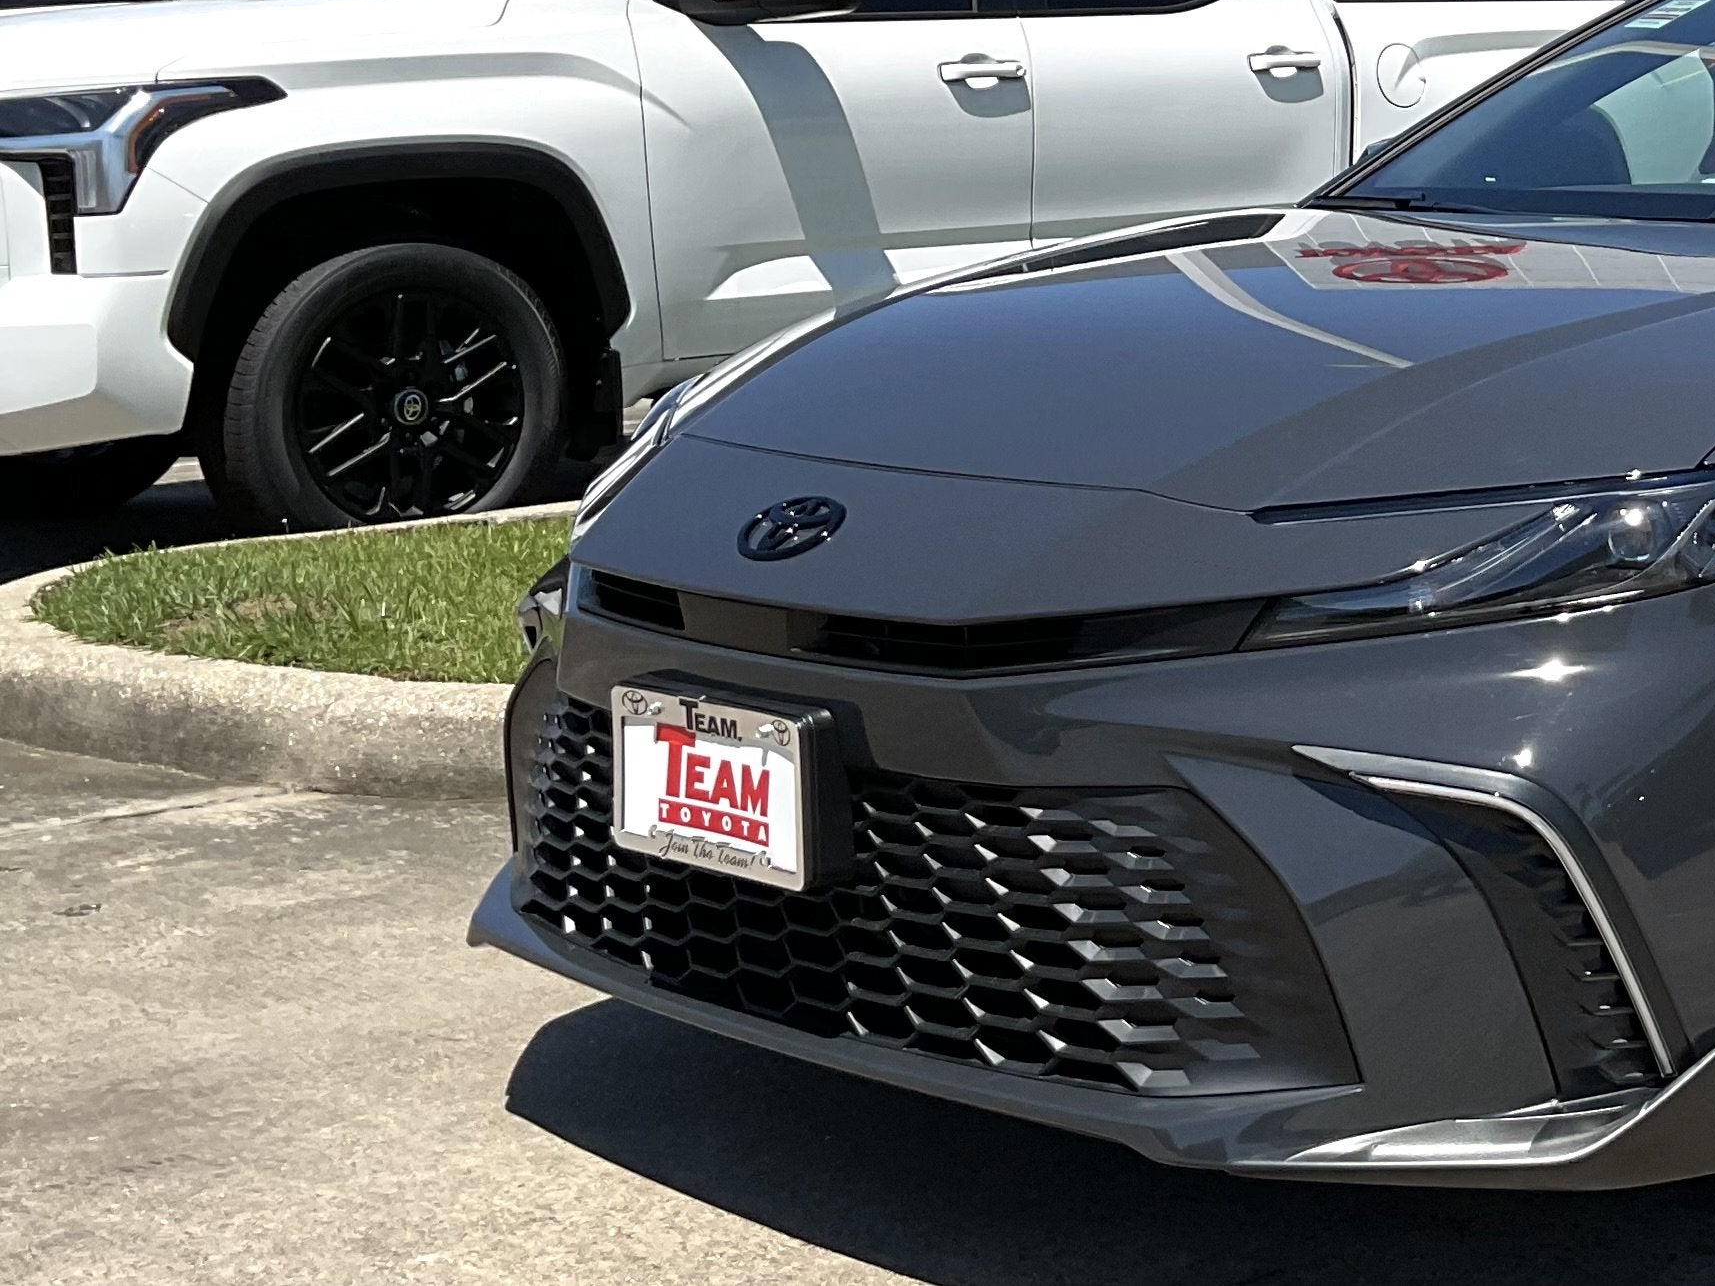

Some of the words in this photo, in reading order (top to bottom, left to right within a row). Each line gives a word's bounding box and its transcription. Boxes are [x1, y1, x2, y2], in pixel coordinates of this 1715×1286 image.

[656, 722, 770, 818] TEAM
[660, 802, 767, 842] TOYOTA
[659, 829, 689, 858] Join
